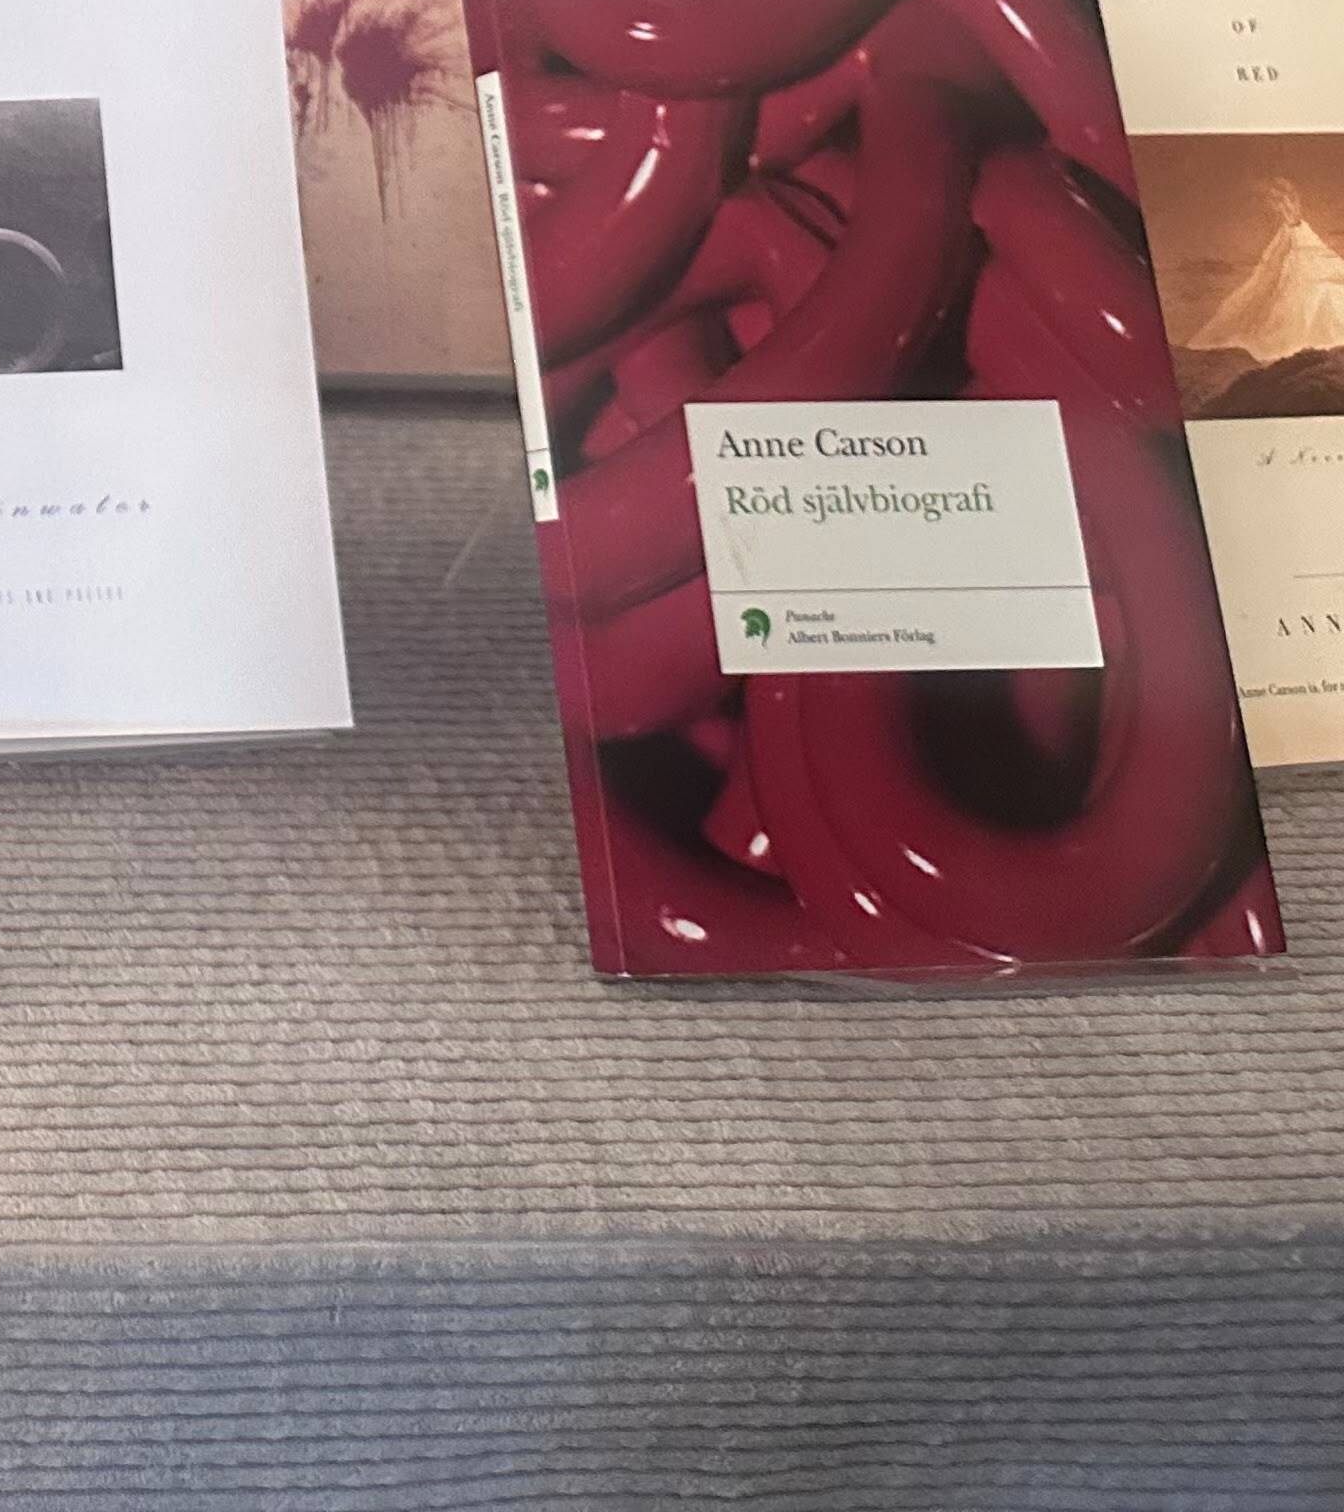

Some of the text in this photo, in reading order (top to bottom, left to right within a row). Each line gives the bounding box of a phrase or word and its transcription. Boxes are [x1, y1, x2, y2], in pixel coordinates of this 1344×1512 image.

[1231, 19, 1257, 34] OF
[1236, 66, 1279, 82] RED
[717, 427, 928, 458] Anne Carson
[724, 483, 994, 524] Röd självbiografi
